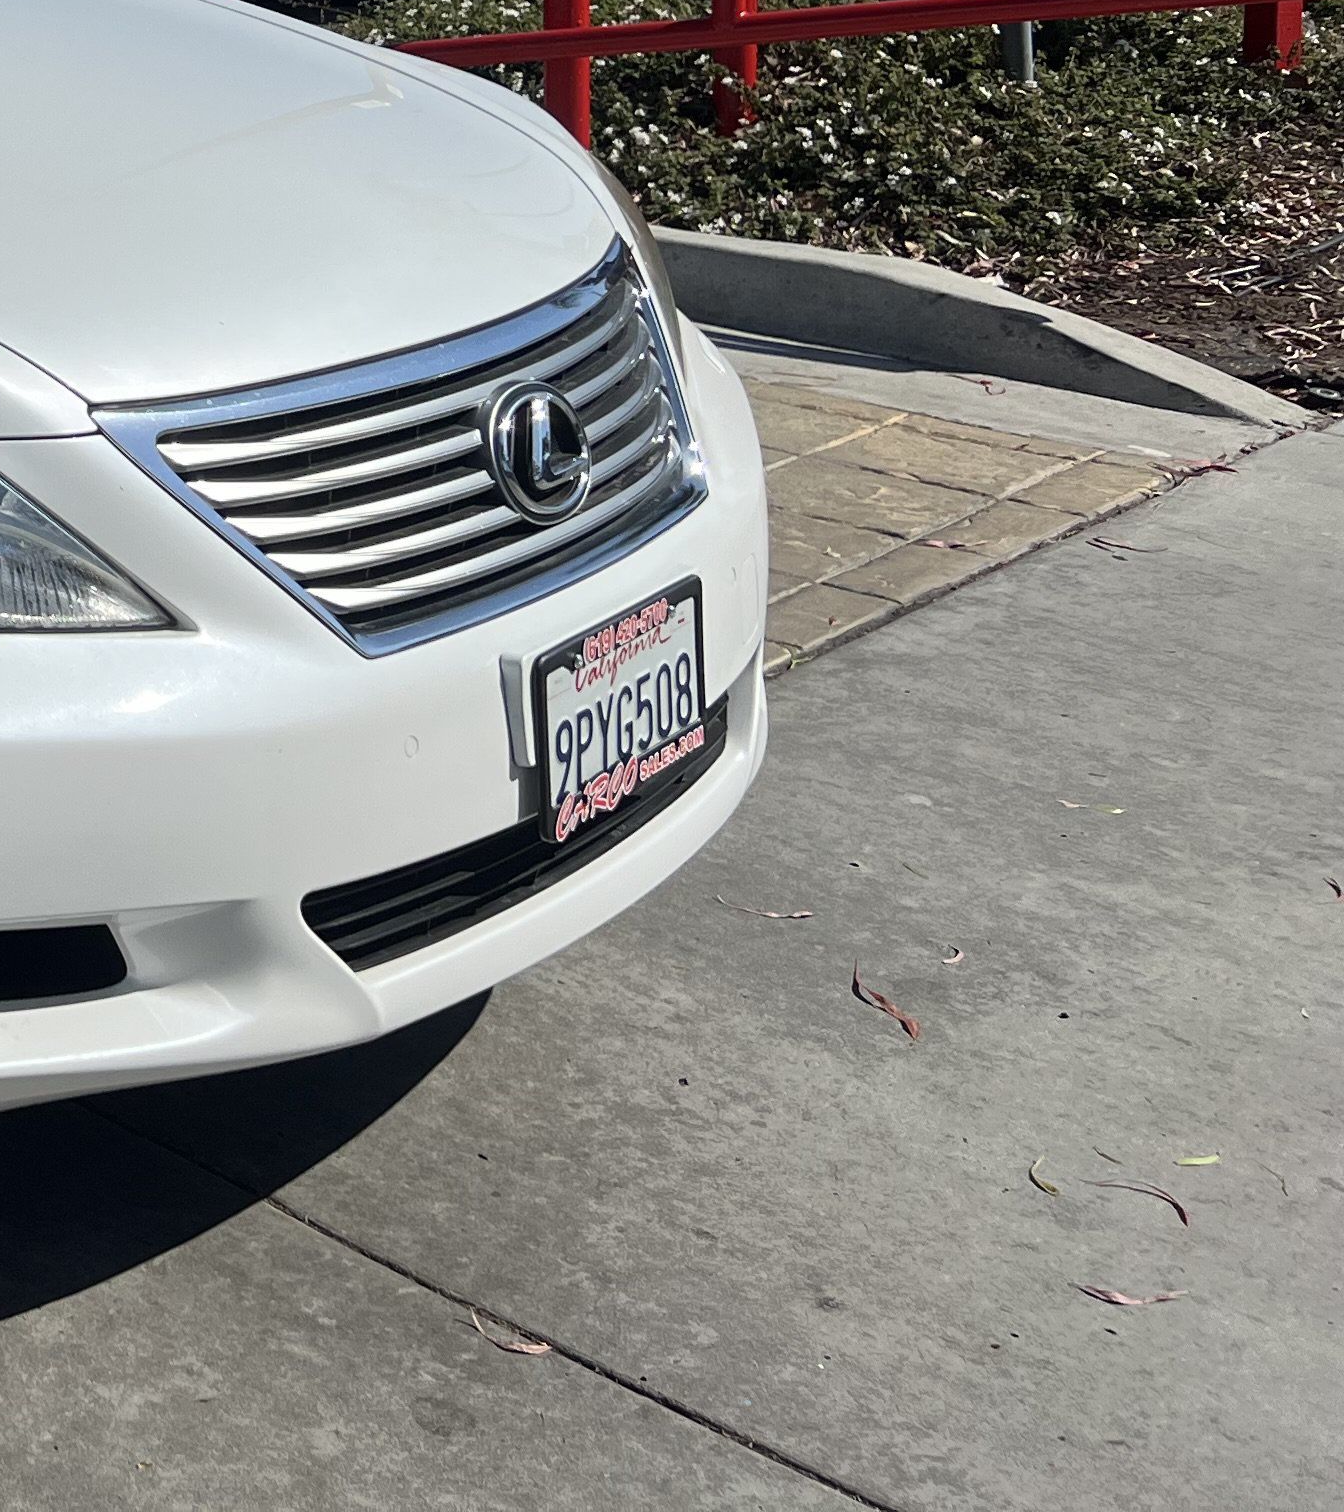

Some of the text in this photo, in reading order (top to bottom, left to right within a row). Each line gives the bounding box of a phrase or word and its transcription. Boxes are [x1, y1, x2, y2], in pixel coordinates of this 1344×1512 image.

[574, 624, 672, 693] California
[582, 597, 669, 663] (619) 420-5700
[554, 651, 693, 805] 9PYG508
[639, 724, 705, 782] SALES.COM
